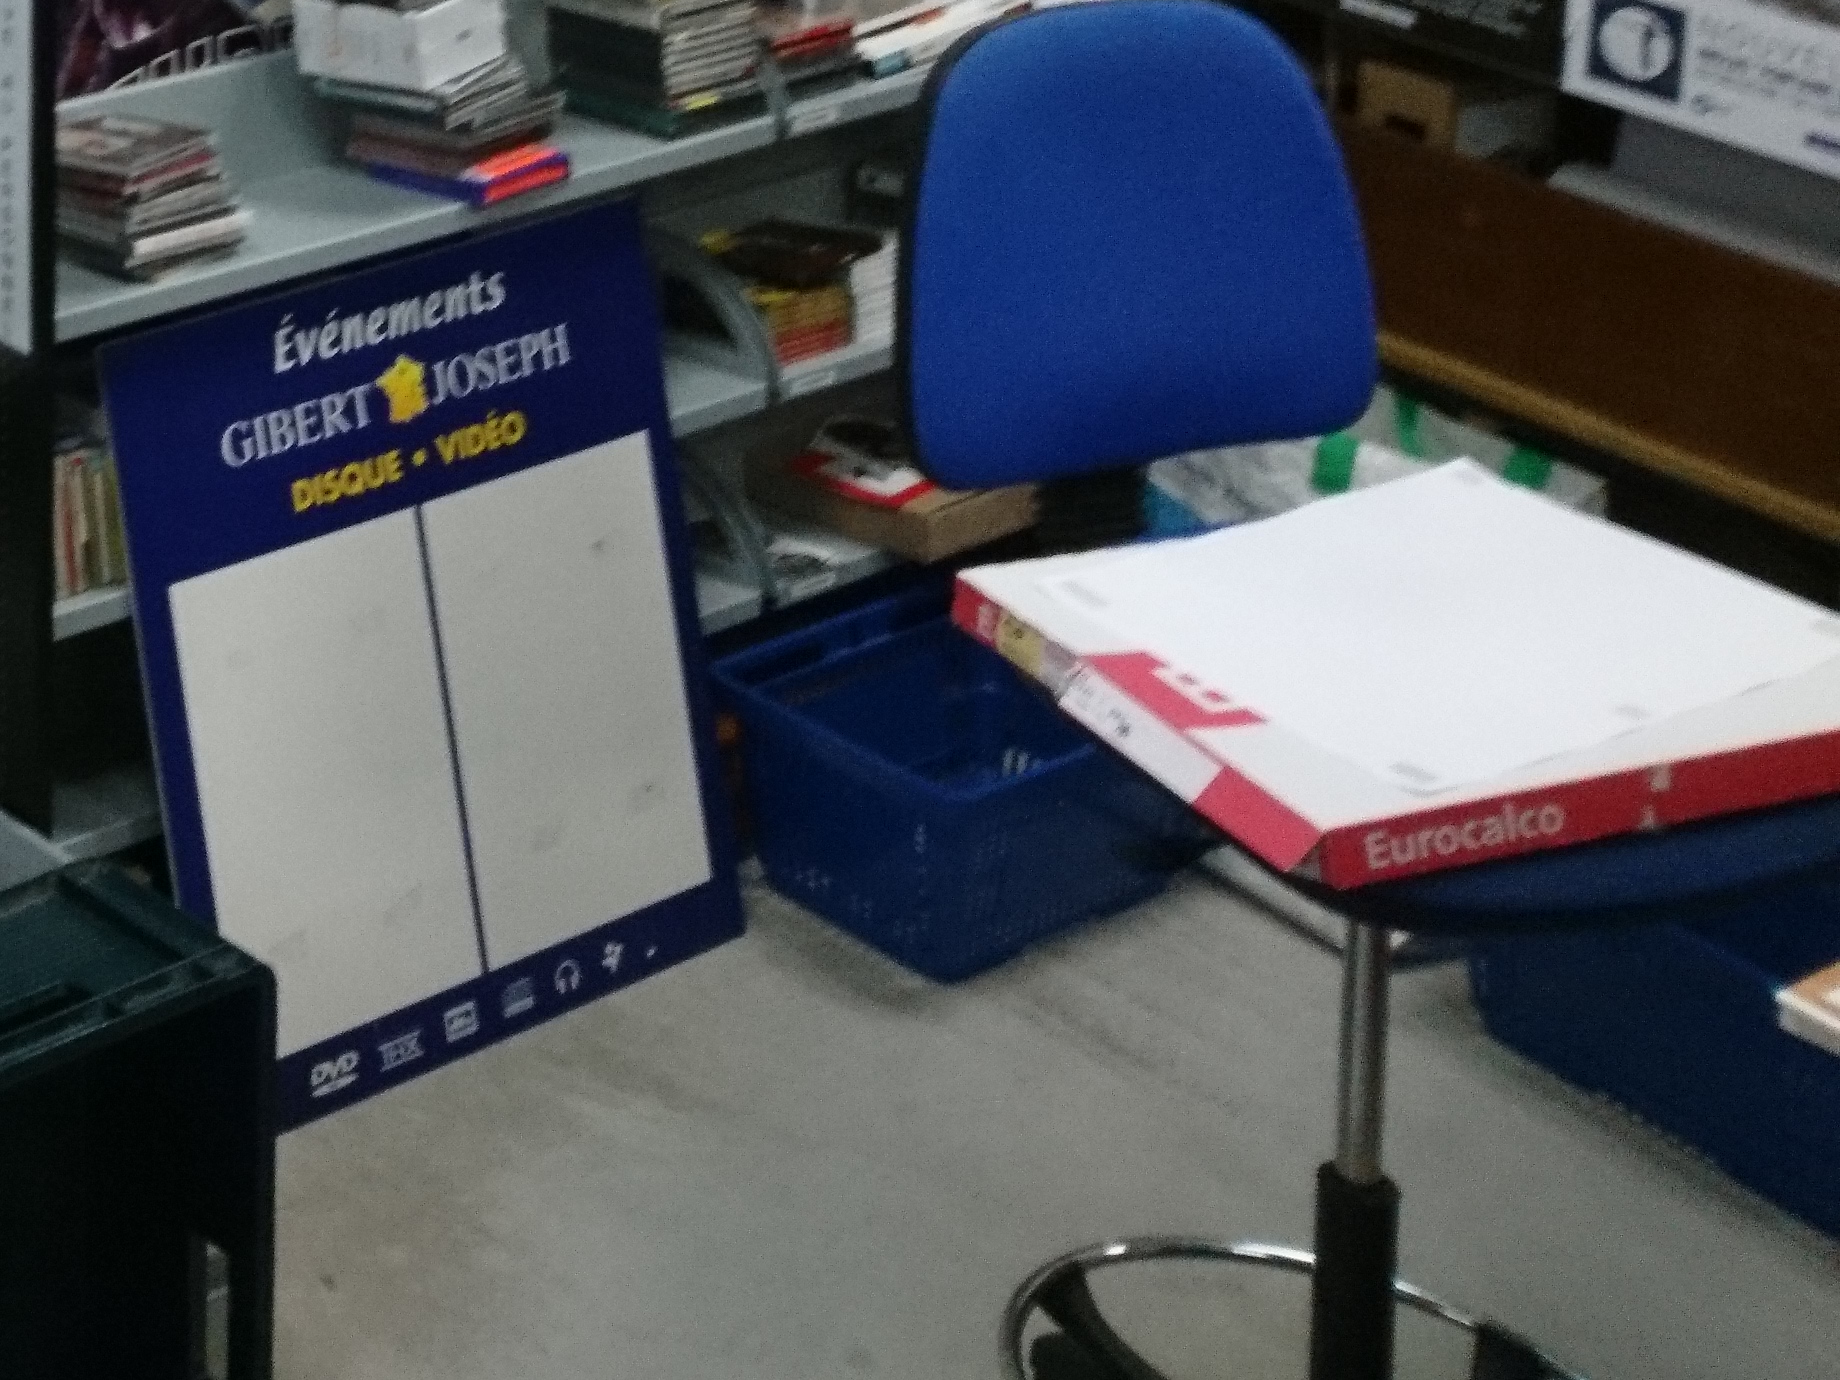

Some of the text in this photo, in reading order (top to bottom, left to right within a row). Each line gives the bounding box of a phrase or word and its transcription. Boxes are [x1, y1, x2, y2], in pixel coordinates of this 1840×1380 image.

[271, 269, 508, 375] Événements
[220, 322, 573, 469] GIBERT JOSEPH
[290, 408, 529, 514] DISQUE VIDÉO
[1362, 796, 1566, 877] Eurocalco
[309, 1048, 361, 1088] DVD
